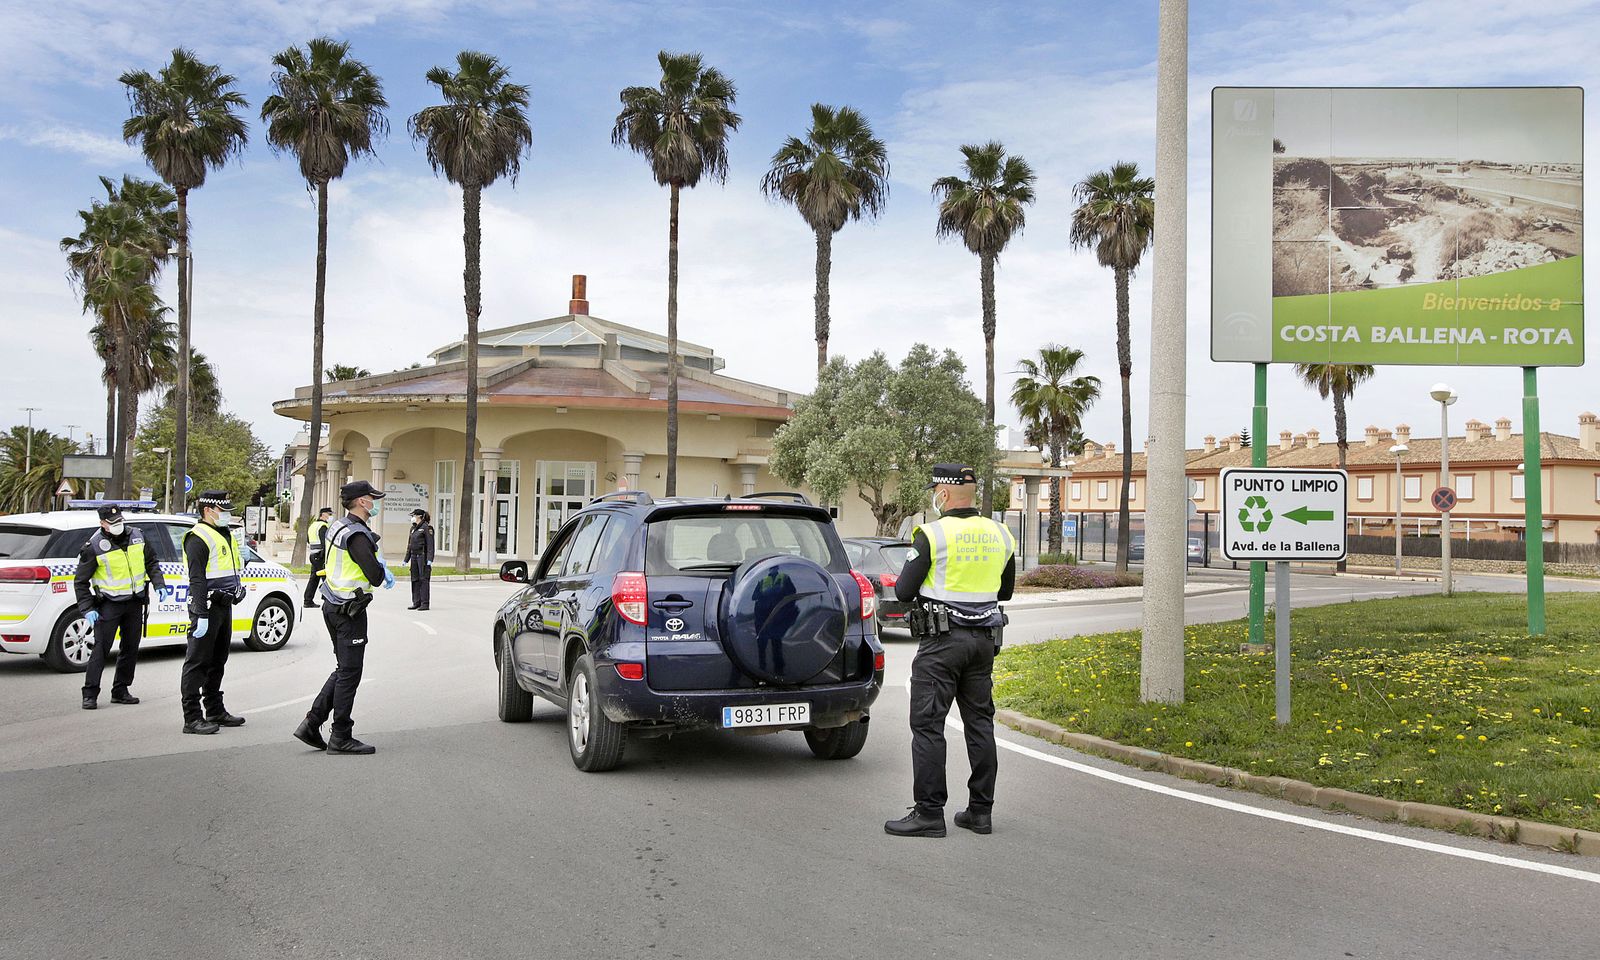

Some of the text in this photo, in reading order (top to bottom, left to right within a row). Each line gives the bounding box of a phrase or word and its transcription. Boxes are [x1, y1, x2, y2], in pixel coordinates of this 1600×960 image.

[1422, 292, 1561, 311] Bienvenidos a
[1280, 324, 1361, 342] COSTA
[1371, 326, 1487, 344] BALLENA
[1503, 327, 1574, 345] ROTA
[1234, 478, 1338, 492] PUNTO LIMPIO
[1232, 541, 1340, 551] Avd. de la Ballena
[735, 705, 806, 723] 9831 FRP
